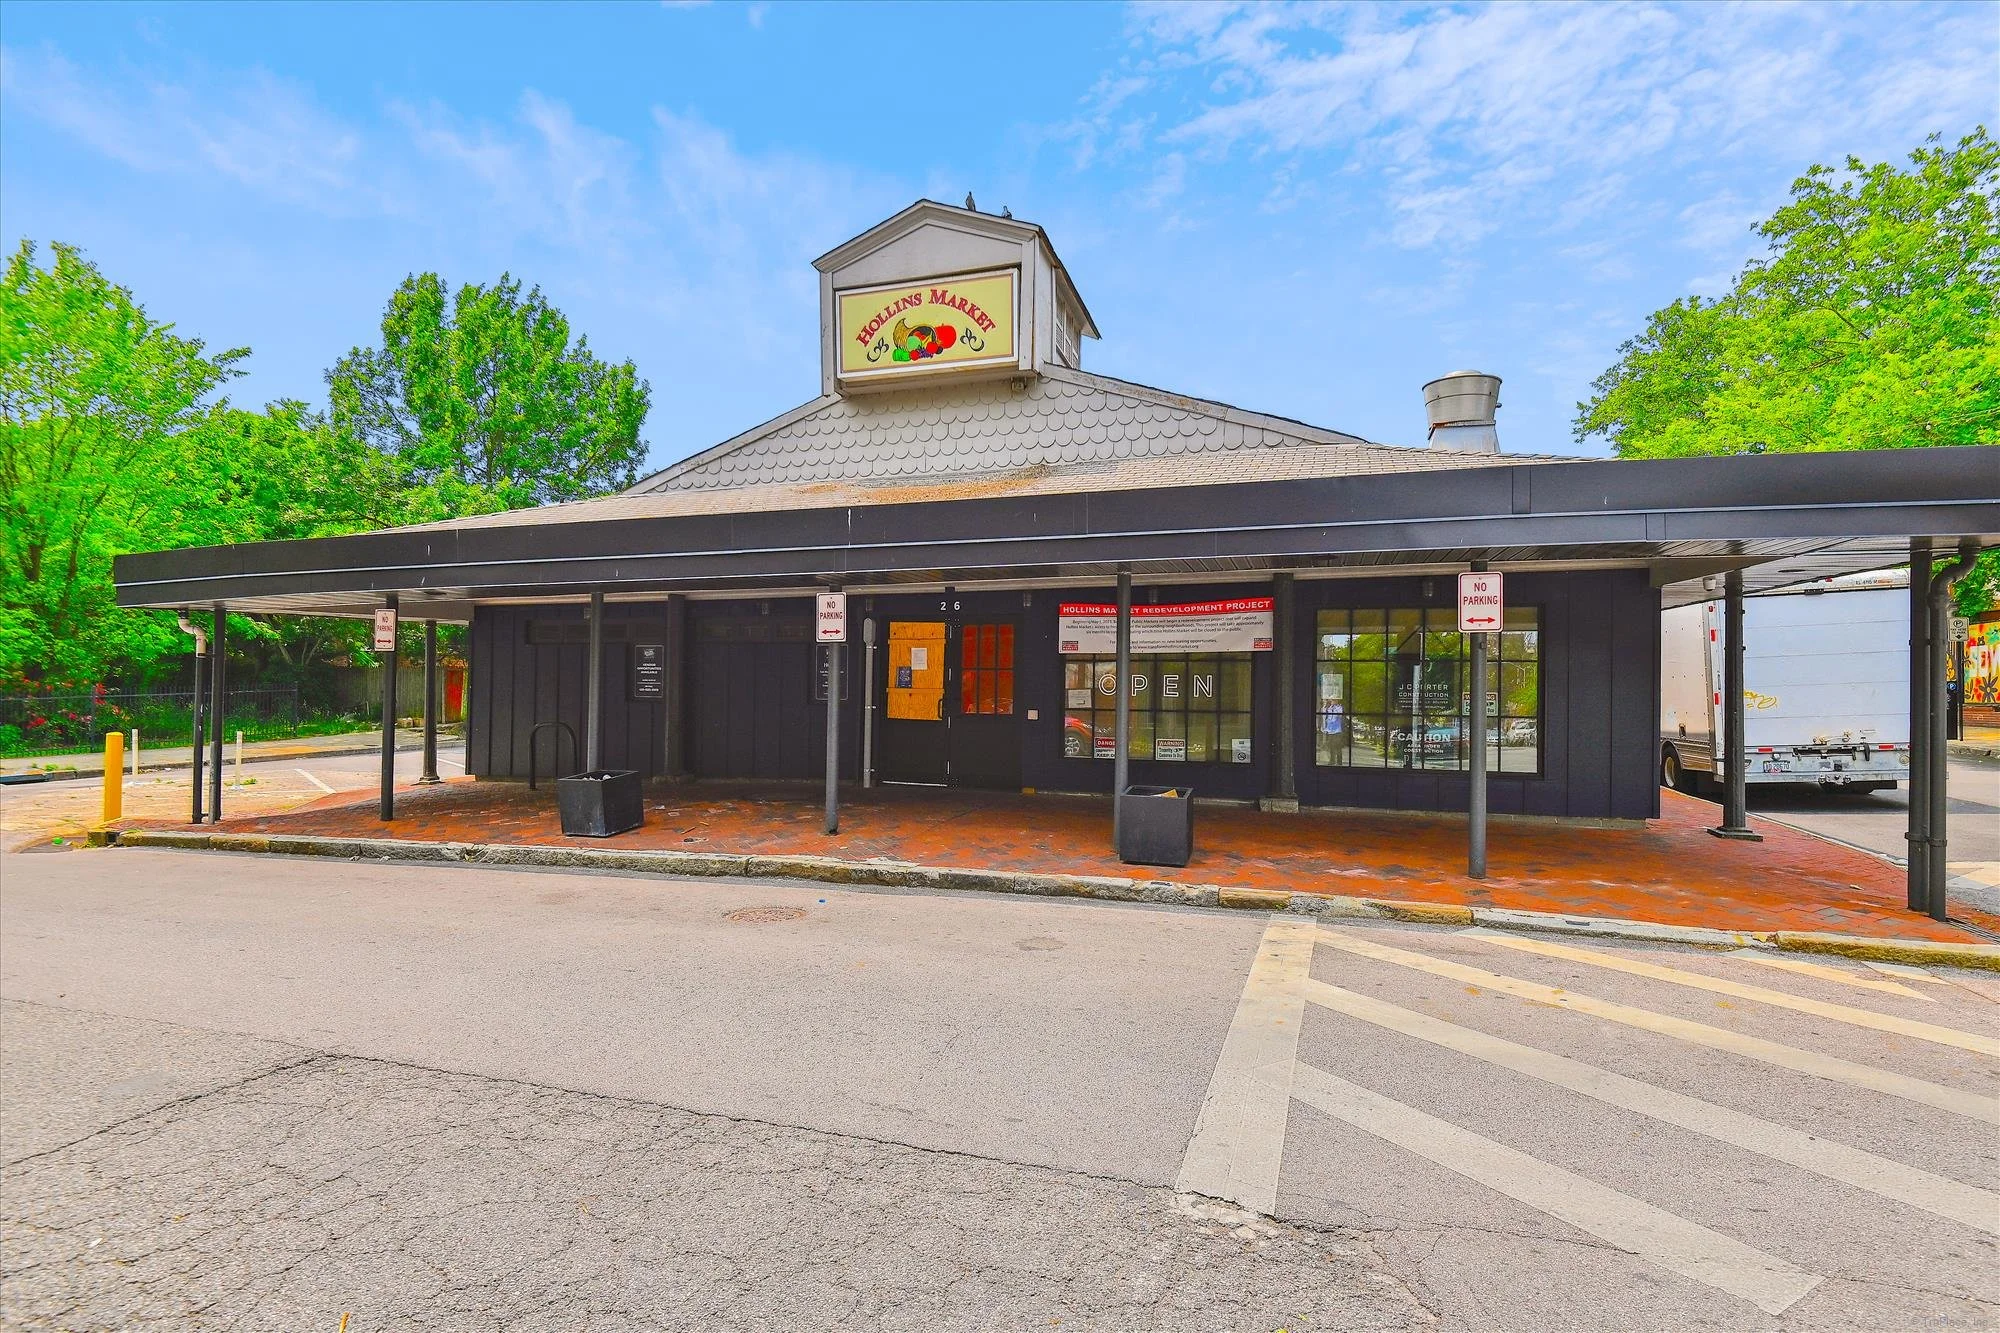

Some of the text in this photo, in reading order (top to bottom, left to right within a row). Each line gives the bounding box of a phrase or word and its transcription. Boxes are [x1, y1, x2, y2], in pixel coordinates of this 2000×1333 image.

[856, 289, 996, 347] HOLLINS MARKET
[1474, 582, 1487, 591] NO
[826, 601, 836, 609] NO
[1463, 595, 1498, 605] PARKING
[1063, 606, 1101, 614] HOLLINS
[1142, 603, 1223, 614] REDEVELOPMENT
[1226, 600, 1271, 610] PROJECT
[819, 611, 843, 620] PARKING
[377, 624, 393, 632] PARKING
[1098, 673, 1213, 698] OPEN
[1397, 732, 1451, 742] CAUTION
